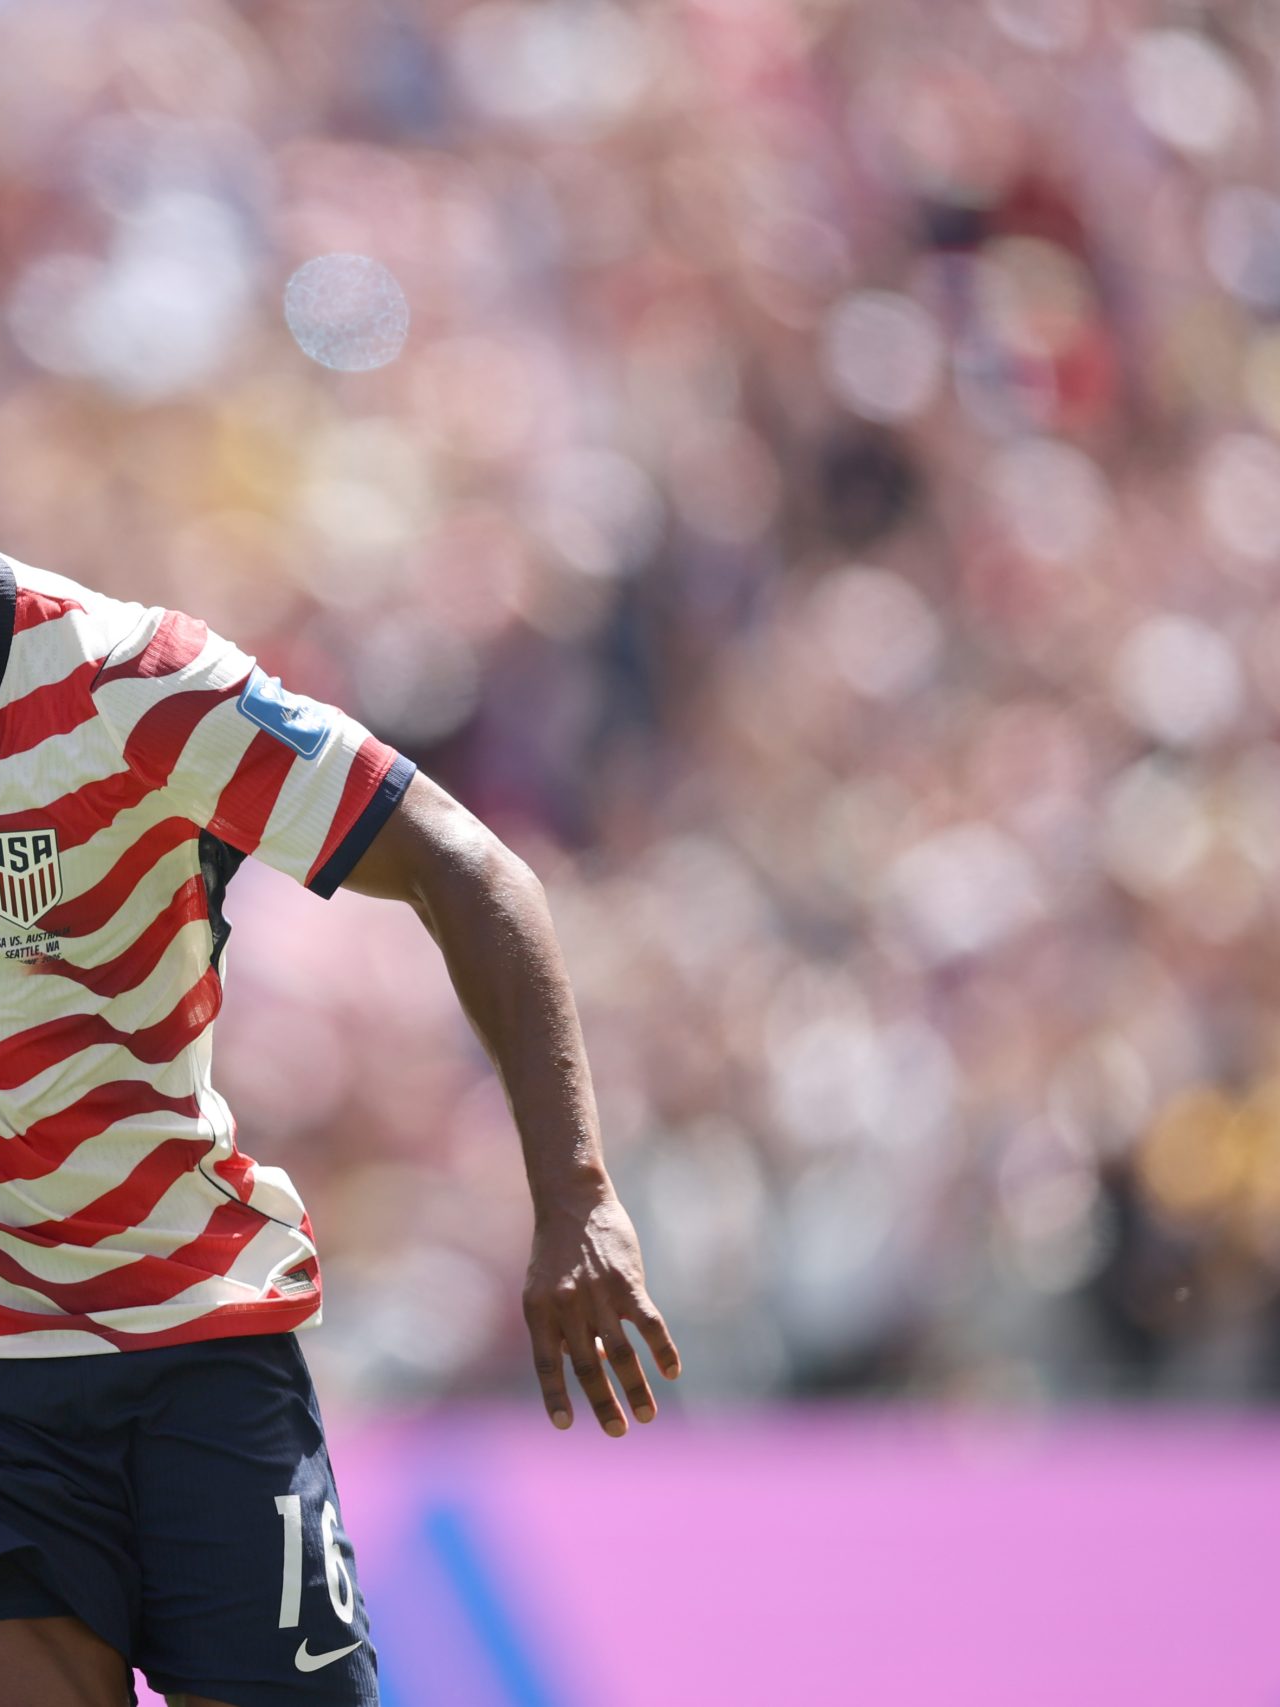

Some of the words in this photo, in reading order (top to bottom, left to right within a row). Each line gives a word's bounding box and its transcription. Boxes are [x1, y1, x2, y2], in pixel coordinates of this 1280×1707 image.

[10, 935, 23, 947] VS.
[26, 927, 70, 943] AUSTRA
[5, 944, 43, 959] SEATTLE,
[46, 940, 60, 952] WA
[274, 1494, 354, 1629] 16
